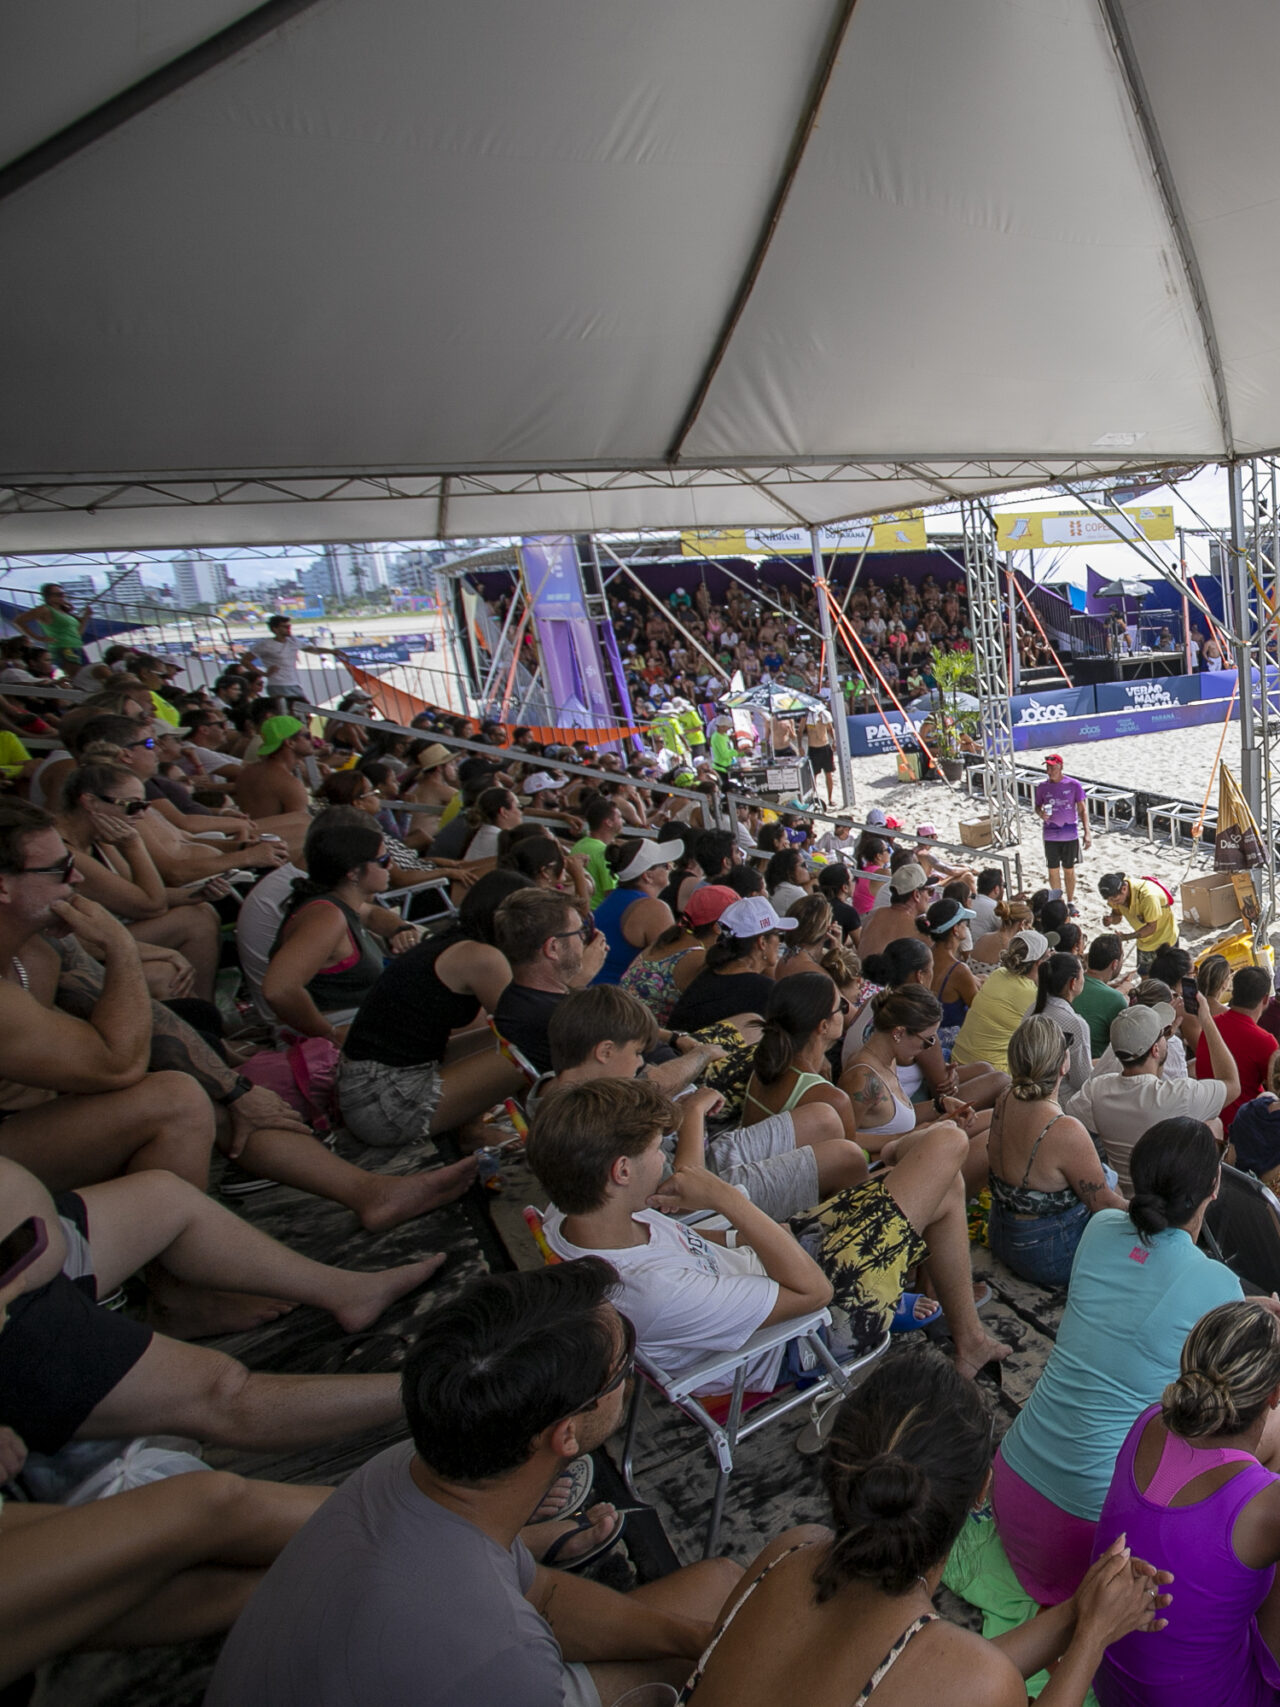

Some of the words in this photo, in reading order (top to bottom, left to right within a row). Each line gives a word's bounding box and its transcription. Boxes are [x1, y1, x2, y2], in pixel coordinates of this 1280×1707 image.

[1085, 522, 1112, 532] COPE
[1126, 682, 1163, 696] VERÃO
[1134, 692, 1170, 704] MAIOR
[1018, 703, 1068, 724] JOGOS
[865, 720, 924, 740] PARAN
